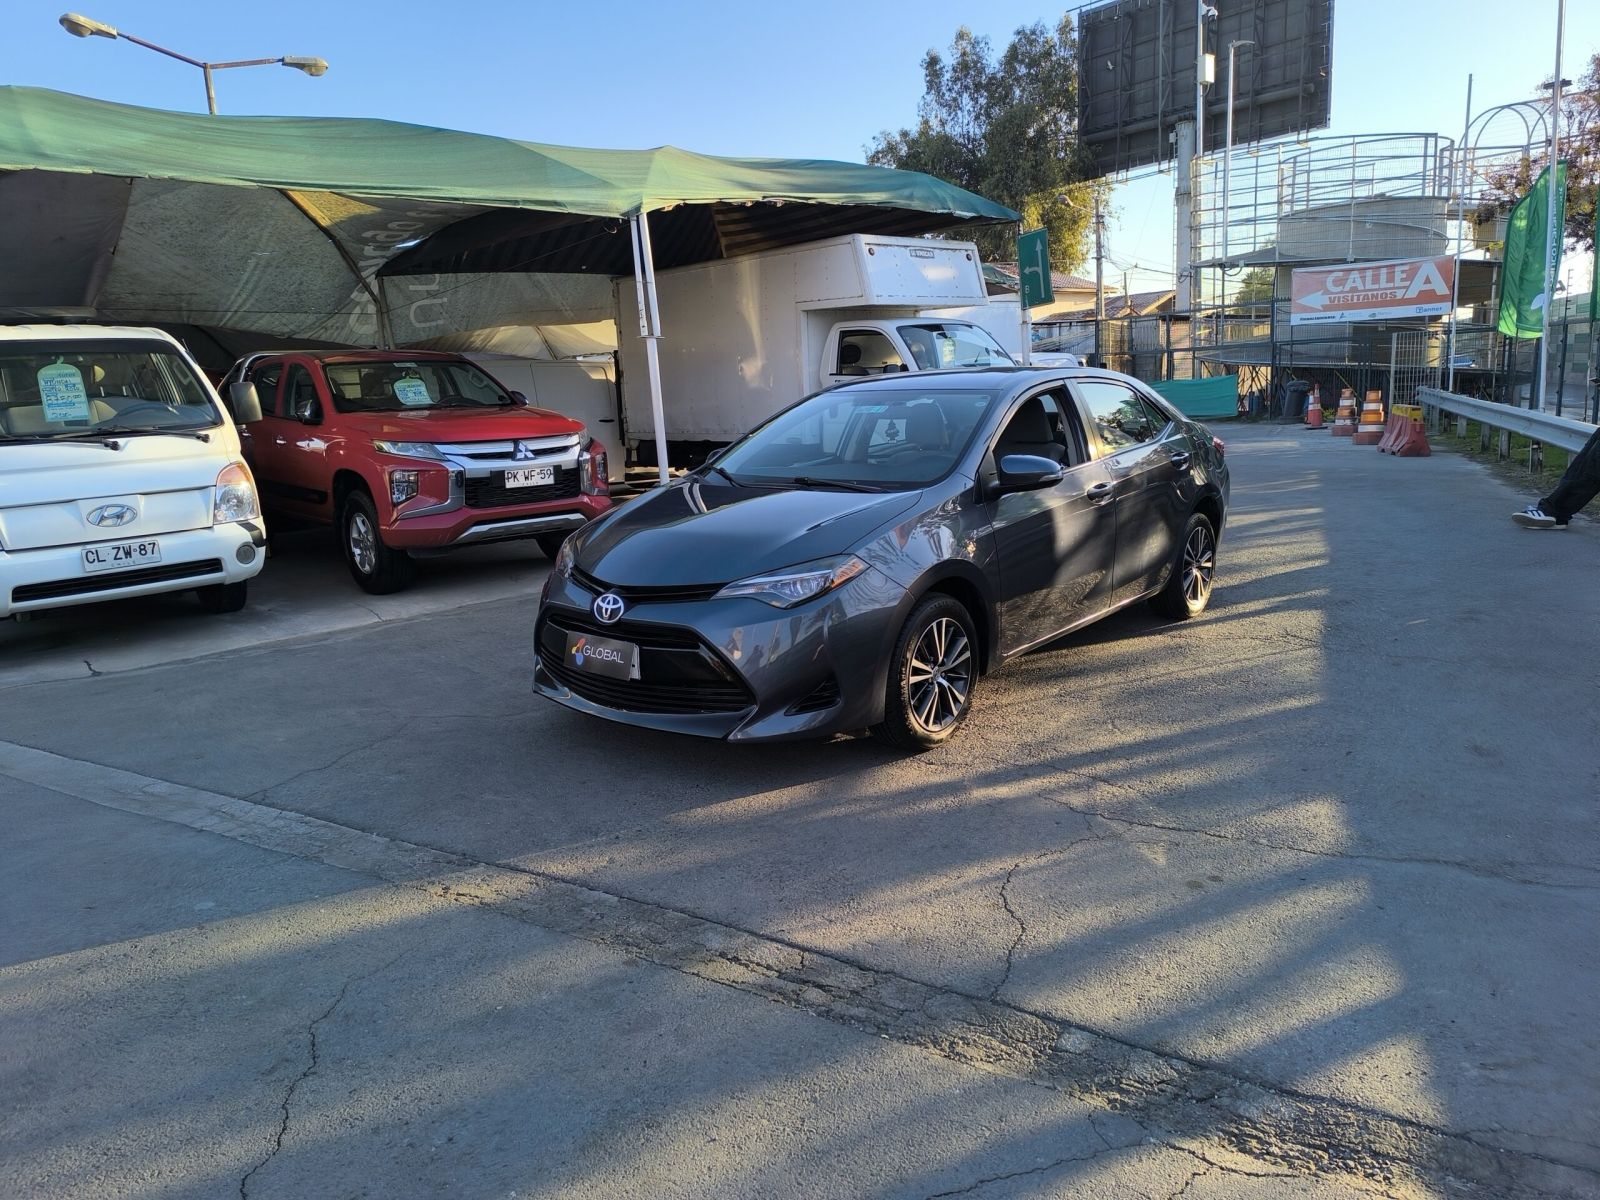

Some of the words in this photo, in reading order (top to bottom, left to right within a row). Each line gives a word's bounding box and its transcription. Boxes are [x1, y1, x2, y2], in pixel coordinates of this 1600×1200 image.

[1326, 264, 1411, 293] CALLE
[1404, 261, 1450, 299] A
[583, 645, 624, 664] GLOBAL
